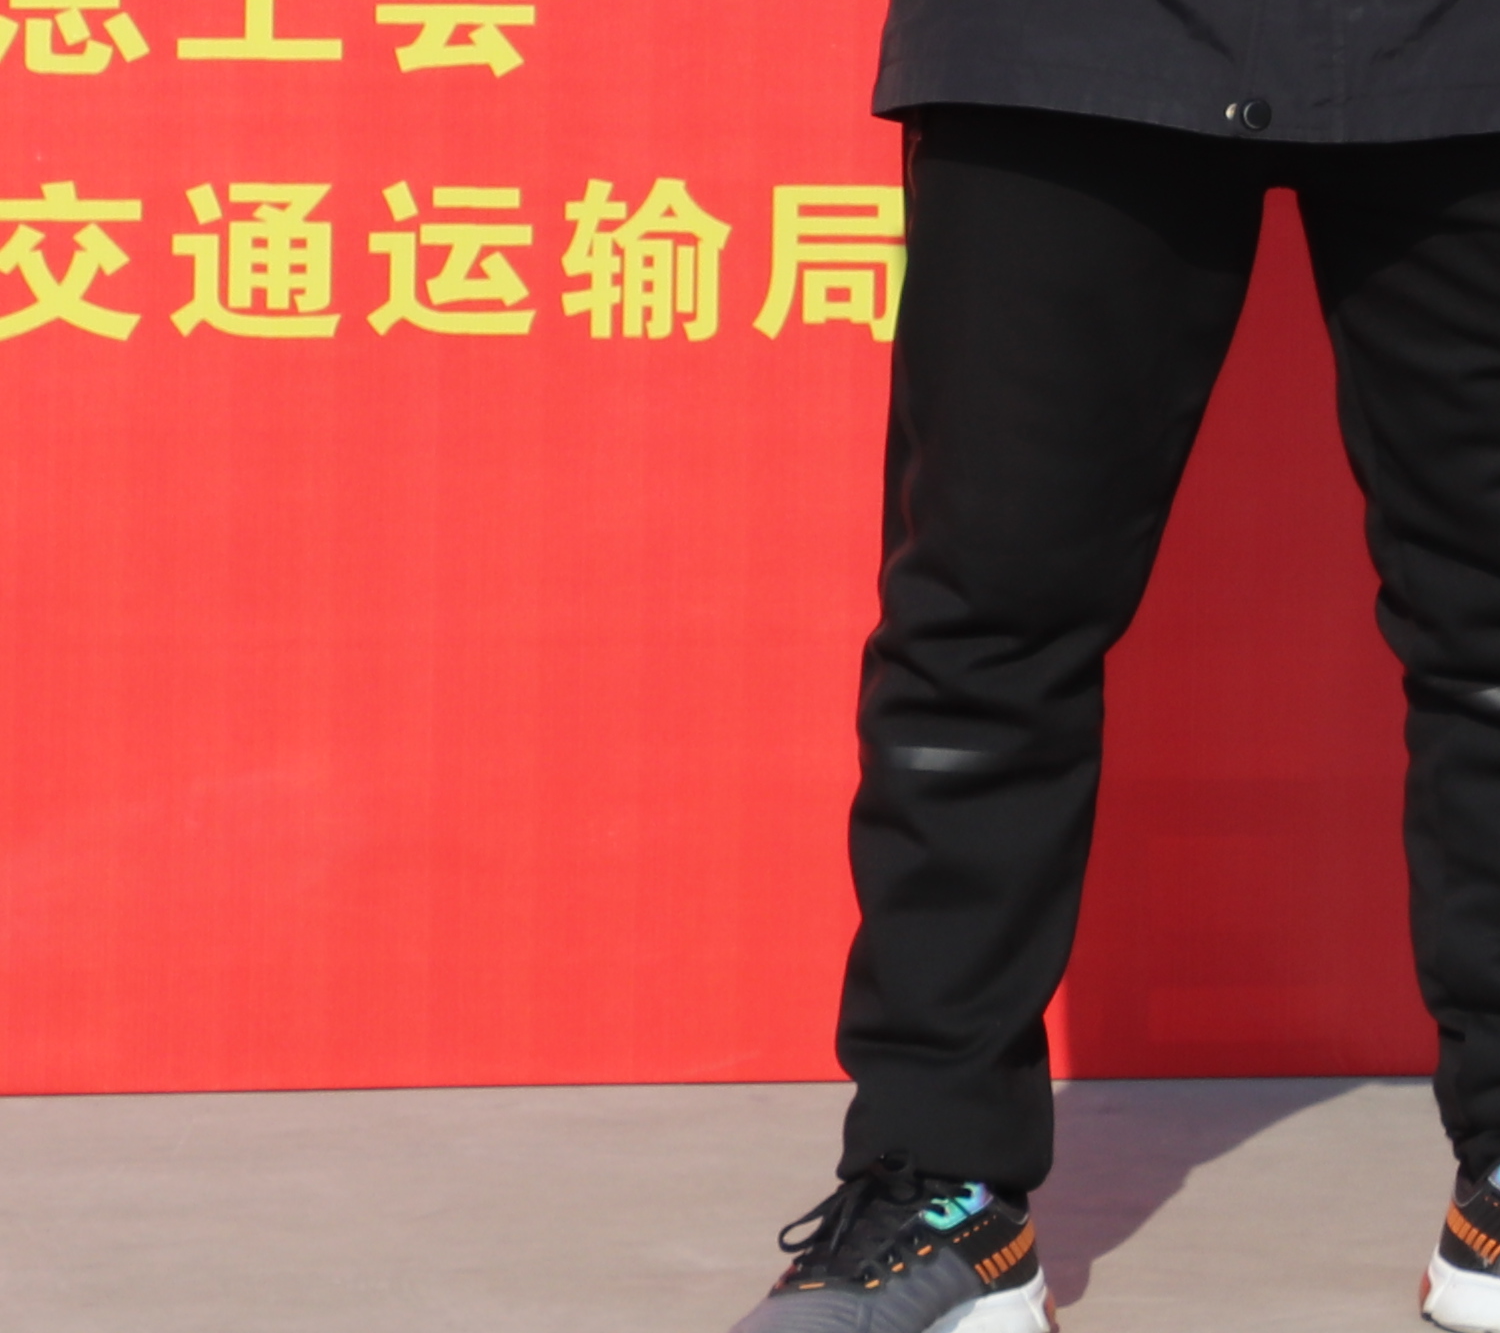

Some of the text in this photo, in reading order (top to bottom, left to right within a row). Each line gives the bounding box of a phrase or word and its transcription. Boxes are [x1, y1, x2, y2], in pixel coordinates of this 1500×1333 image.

[0, 178, 909, 342] 交通运输局
